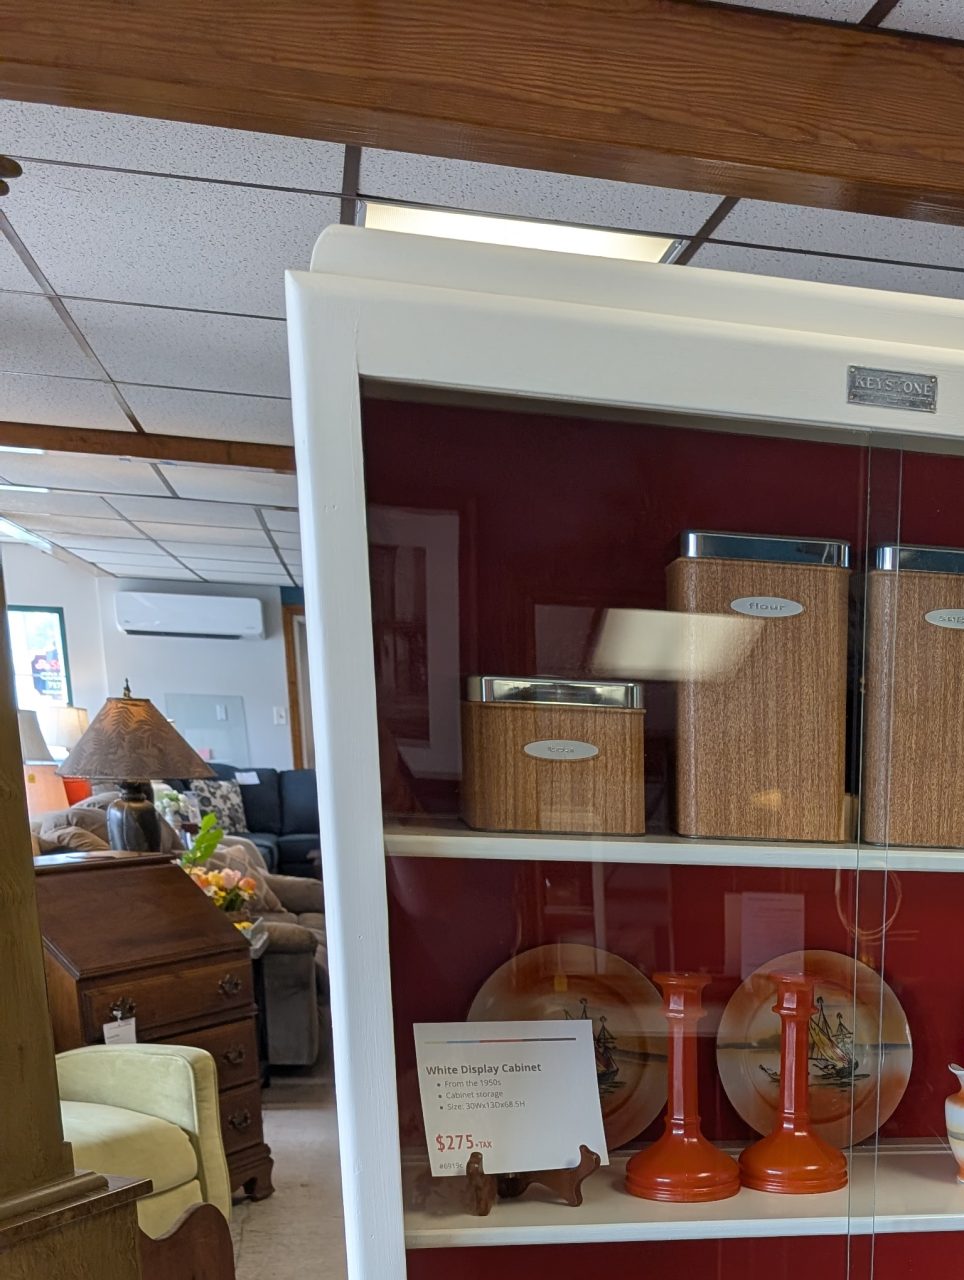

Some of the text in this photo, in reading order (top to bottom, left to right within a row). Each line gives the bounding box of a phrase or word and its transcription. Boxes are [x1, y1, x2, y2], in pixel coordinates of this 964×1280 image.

[855, 376, 933, 395] KEYSONE
[749, 602, 785, 611] flour
[425, 1063, 542, 1076] White Display Cabinet
[444, 1078, 502, 1088] From the 1950s
[445, 1090, 504, 1099] Cabinet storage
